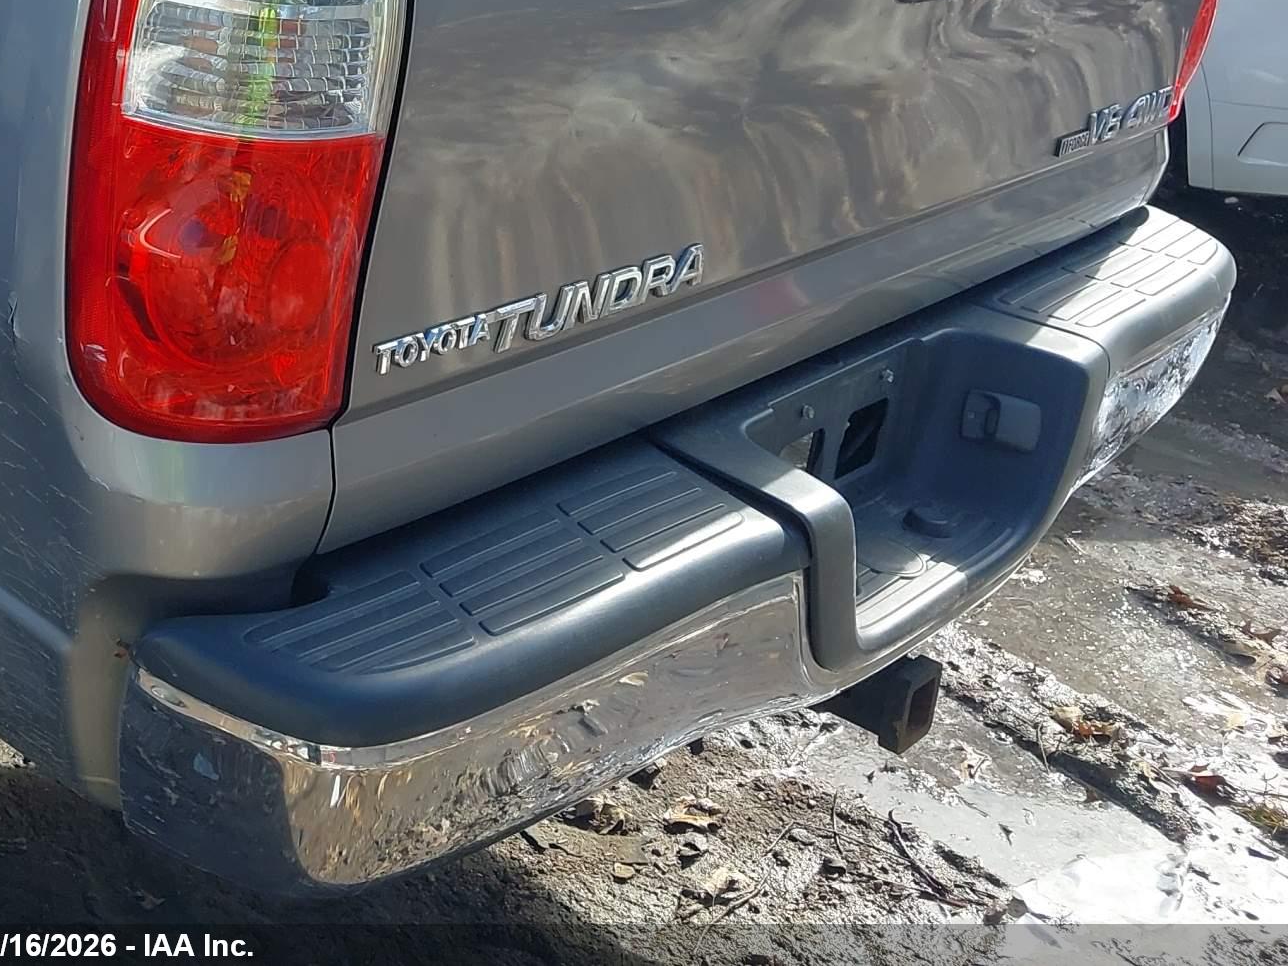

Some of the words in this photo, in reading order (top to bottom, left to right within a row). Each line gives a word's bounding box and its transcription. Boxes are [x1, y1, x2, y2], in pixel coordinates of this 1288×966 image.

[1090, 103, 1122, 144] V8
[372, 314, 491, 375] TOYOTA
[489, 243, 705, 353] TUNDRA
